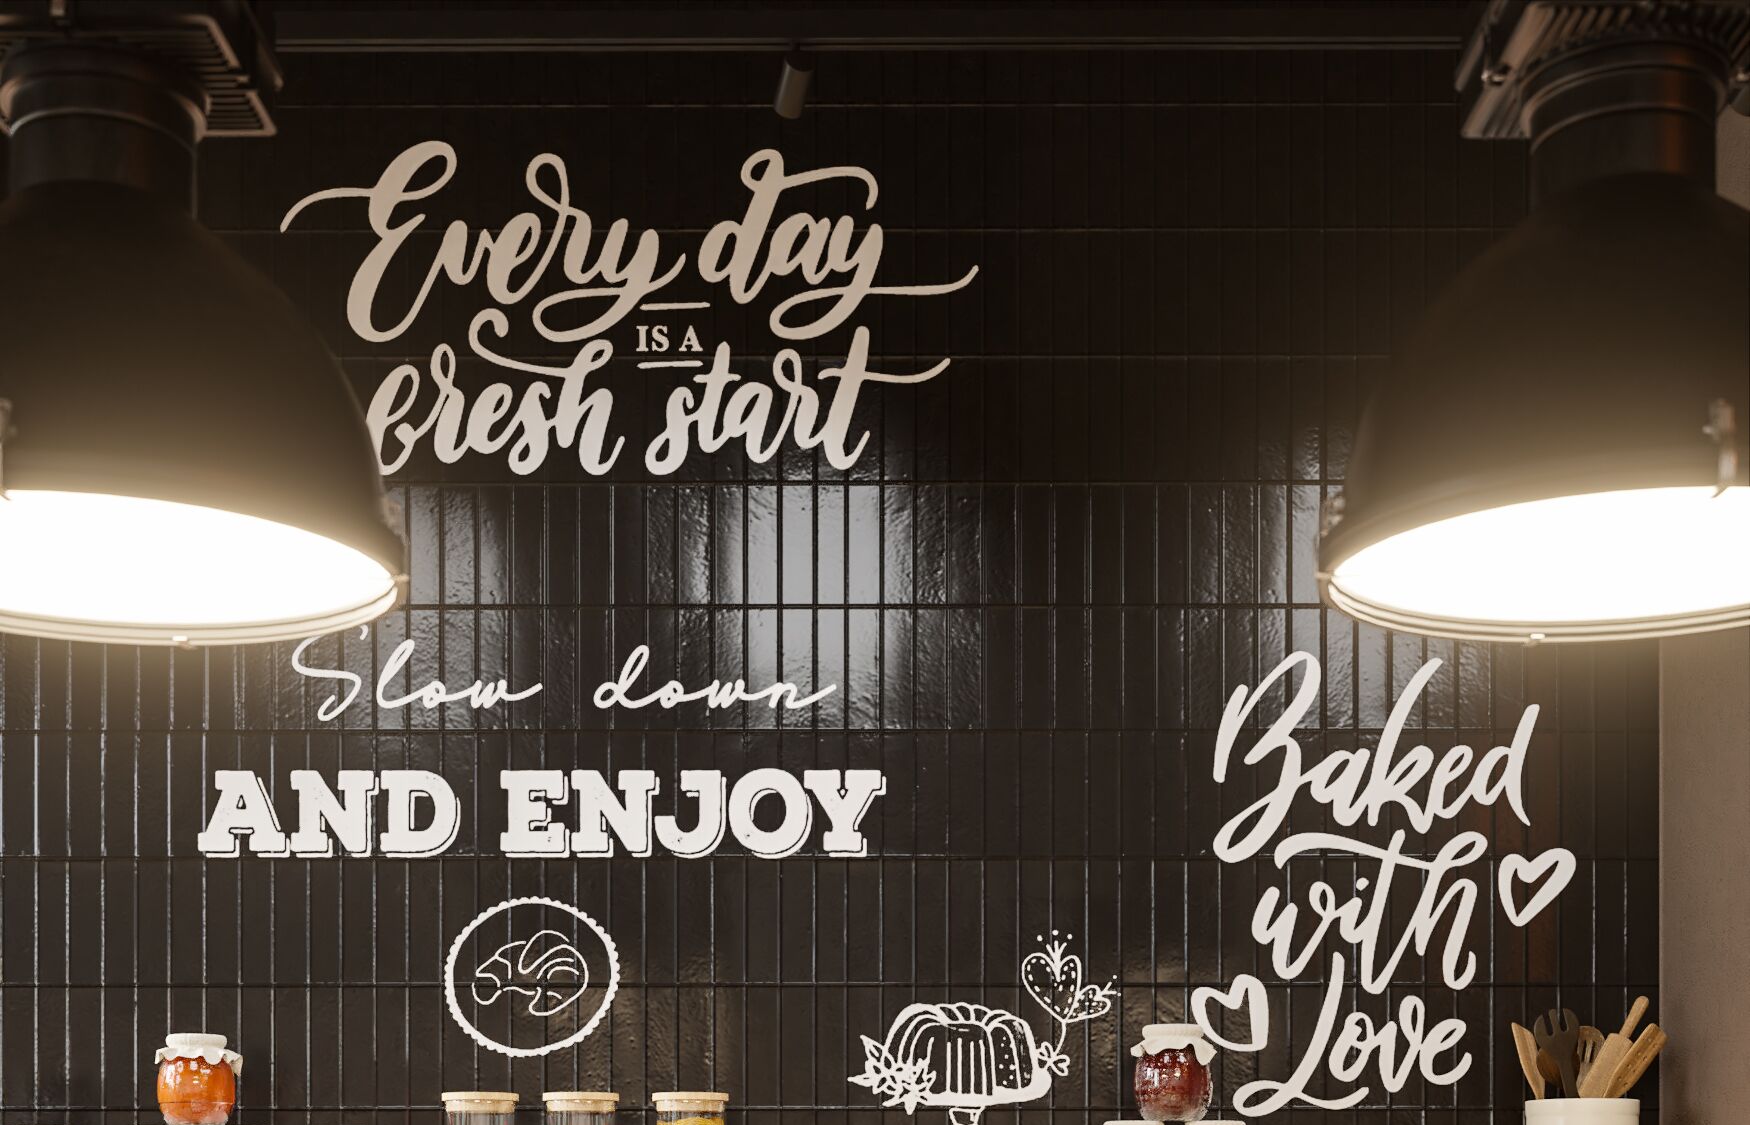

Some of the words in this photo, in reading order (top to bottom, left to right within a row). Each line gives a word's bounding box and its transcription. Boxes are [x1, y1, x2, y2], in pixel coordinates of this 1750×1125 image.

[280, 140, 687, 343] Every
[698, 148, 978, 340] day
[636, 325, 670, 353] IS
[678, 325, 704, 352] A
[644, 325, 951, 476] start
[291, 625, 543, 722] Slow
[593, 643, 838, 710] down
[198, 769, 461, 859] AND
[500, 767, 887, 860] ENJOY
[1212, 650, 1541, 864] Baked
[1252, 829, 1488, 995] with
[1232, 951, 1473, 1117] Love
